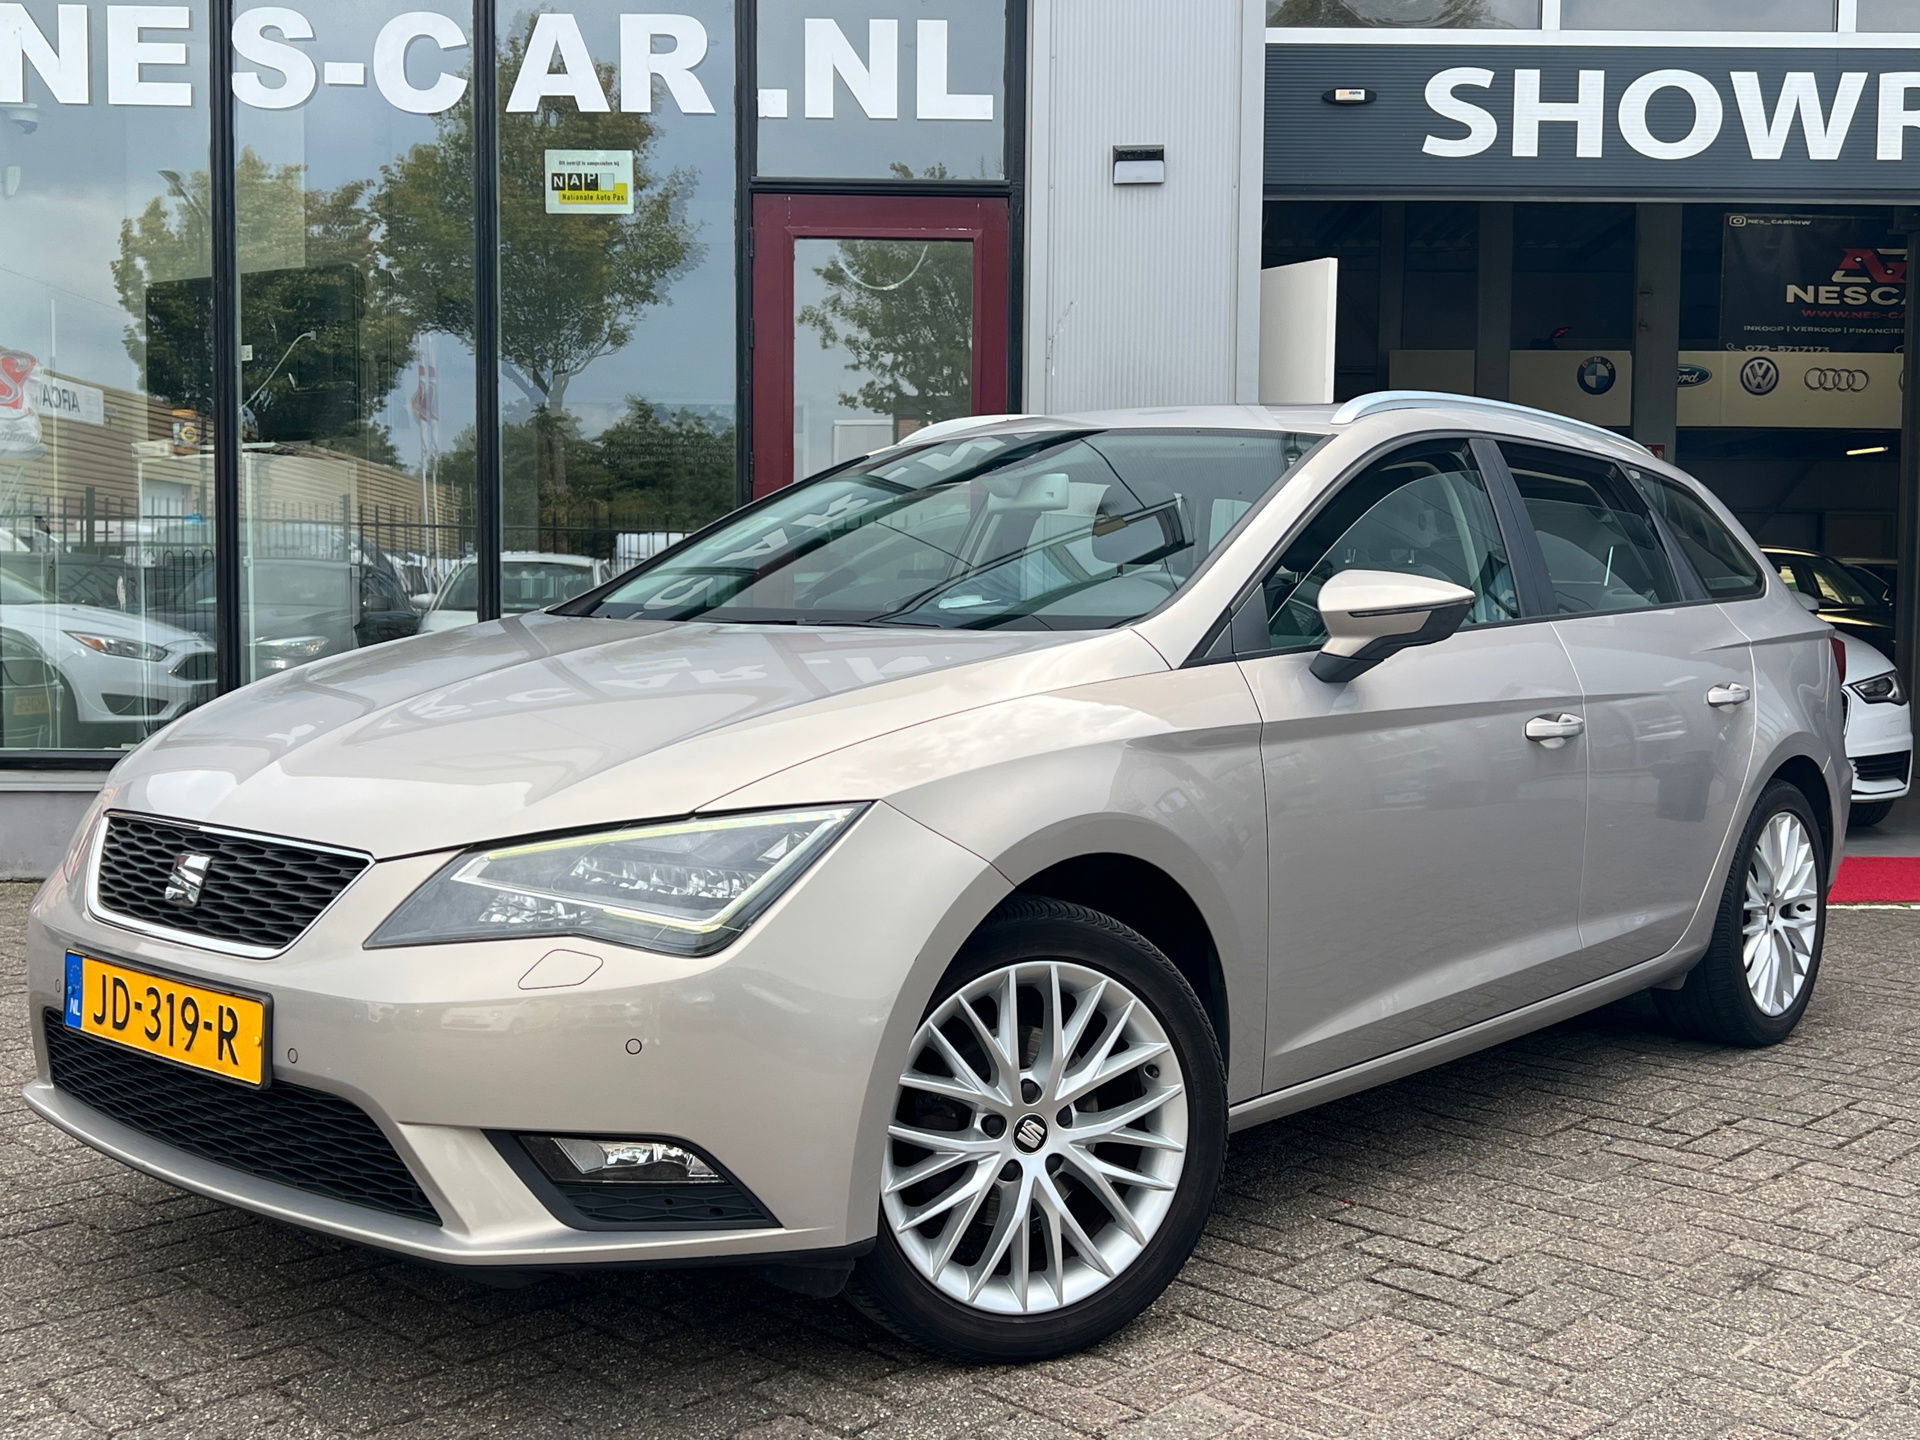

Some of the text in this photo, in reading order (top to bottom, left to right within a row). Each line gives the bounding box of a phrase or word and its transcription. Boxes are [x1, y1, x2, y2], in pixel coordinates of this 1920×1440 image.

[553, 173, 597, 188] NAP
[562, 193, 625, 201] Nationale Auto Pas
[1786, 284, 1906, 305] NESC
[1792, 326, 1842, 334] VERKOOP
[68, 996, 82, 1017] NL
[93, 973, 240, 1067] JD-319-R
